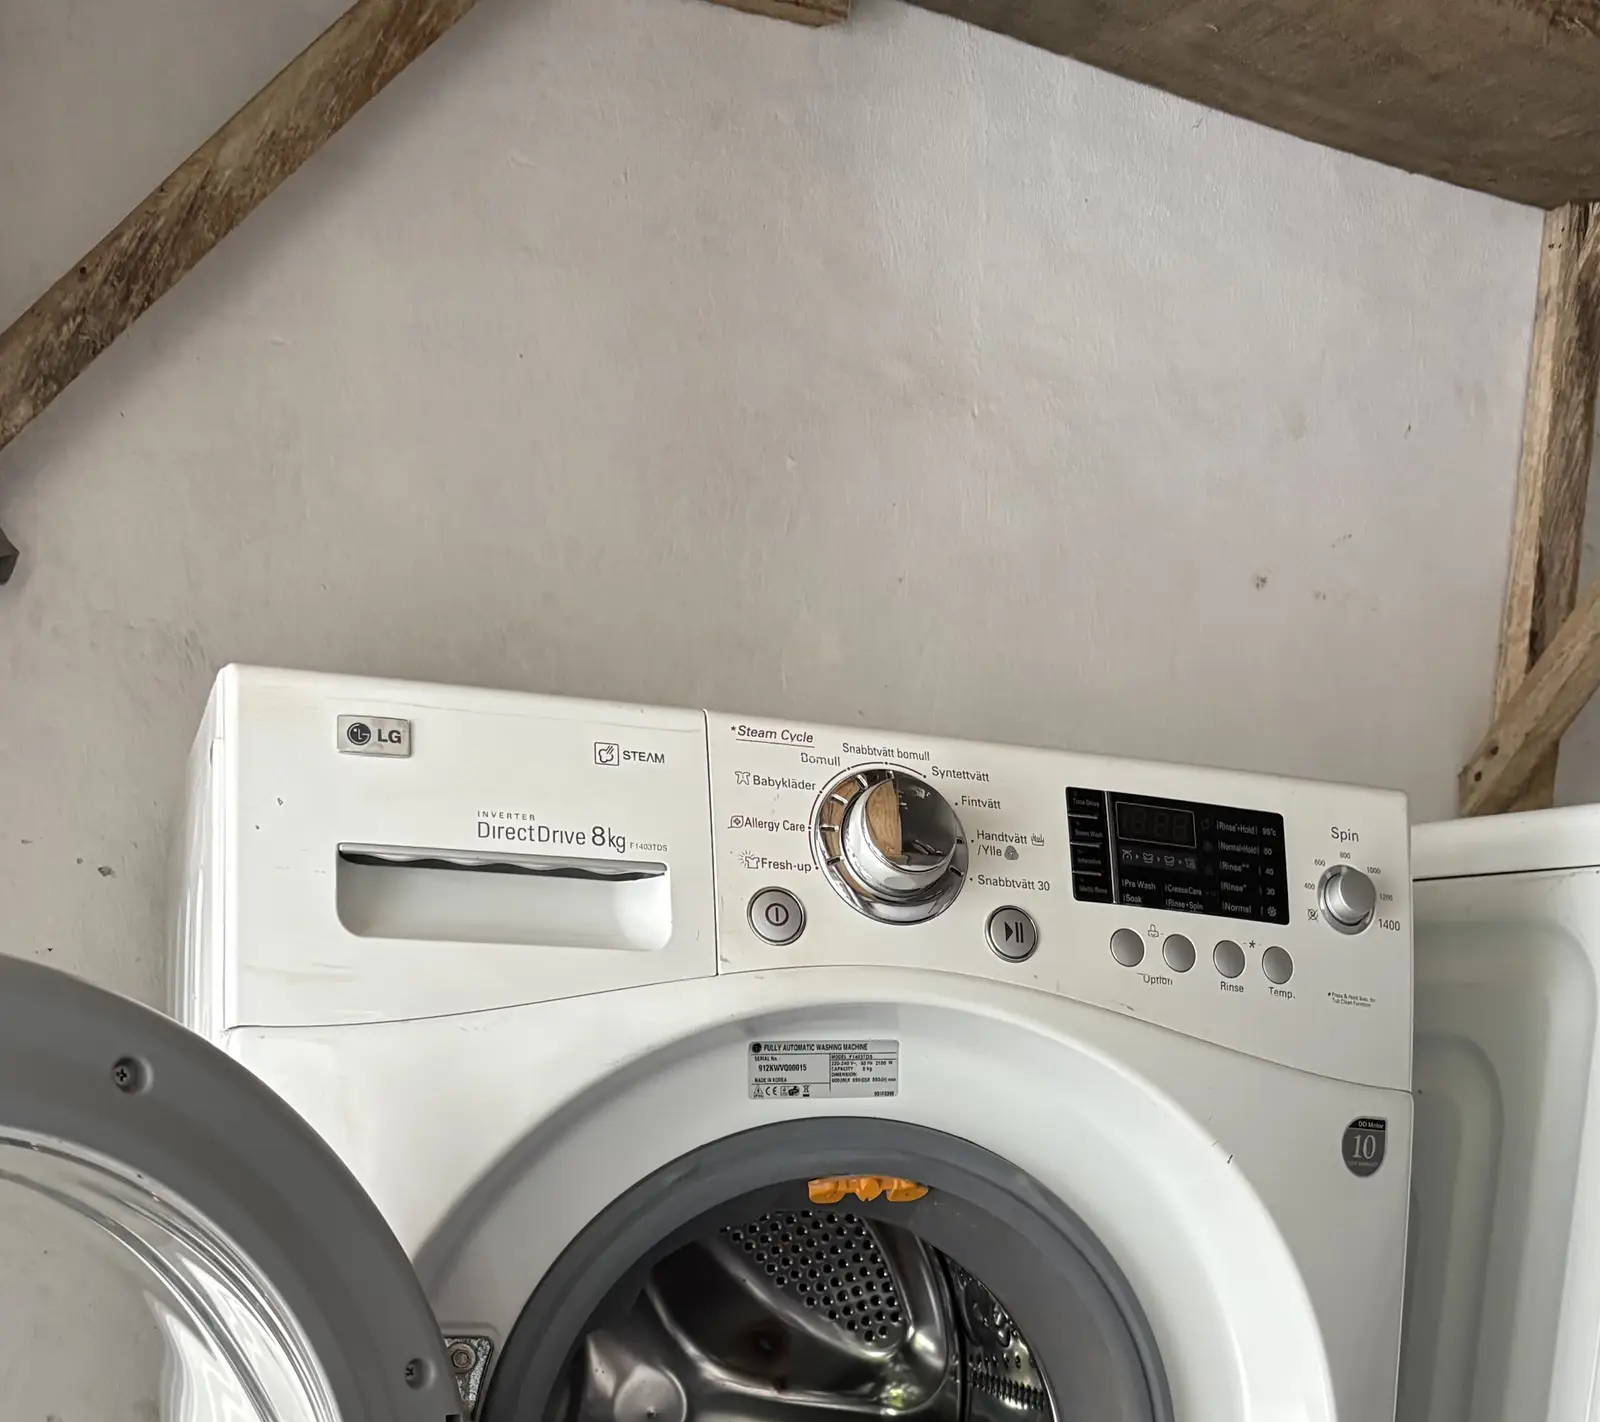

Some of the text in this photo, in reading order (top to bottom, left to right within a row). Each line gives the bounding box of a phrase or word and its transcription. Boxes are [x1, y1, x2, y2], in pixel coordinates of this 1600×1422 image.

[377, 728, 402, 744] LG
[780, 729, 815, 745] Cycle
[622, 750, 666, 764] STEAM
[842, 743, 931, 761] Snabbtvätt bomull
[931, 766, 990, 783] Syntettvätt
[752, 775, 817, 792] Babykläder
[961, 796, 1002, 810] Fintvätt
[477, 810, 536, 821] INVERTER
[744, 816, 806, 833] Allergy Care
[976, 830, 1028, 845] Handtvätt
[1331, 826, 1360, 843] Spin
[1339, 851, 1351, 860] 800
[760, 857, 812, 874] Fresh-up
[1265, 867, 1274, 876] 40
[1366, 866, 1381, 875] 1000
[977, 874, 1051, 892] Snabbtvätt 30
[1137, 880, 1156, 890] Wash
[1304, 882, 1316, 890] 400
[1126, 893, 1142, 904] Soak
[1266, 888, 1275, 896] 30
[1379, 893, 1394, 901] 1200
[1225, 902, 1252, 914] Normal
[1378, 918, 1401, 932] 1400
[1220, 980, 1244, 993] Rinse
[1268, 986, 1296, 1000] Temp.
[763, 1043, 868, 1052] FULLY AUTOMATIC WASHING MACHINE
[1352, 1134, 1376, 1160] 10
